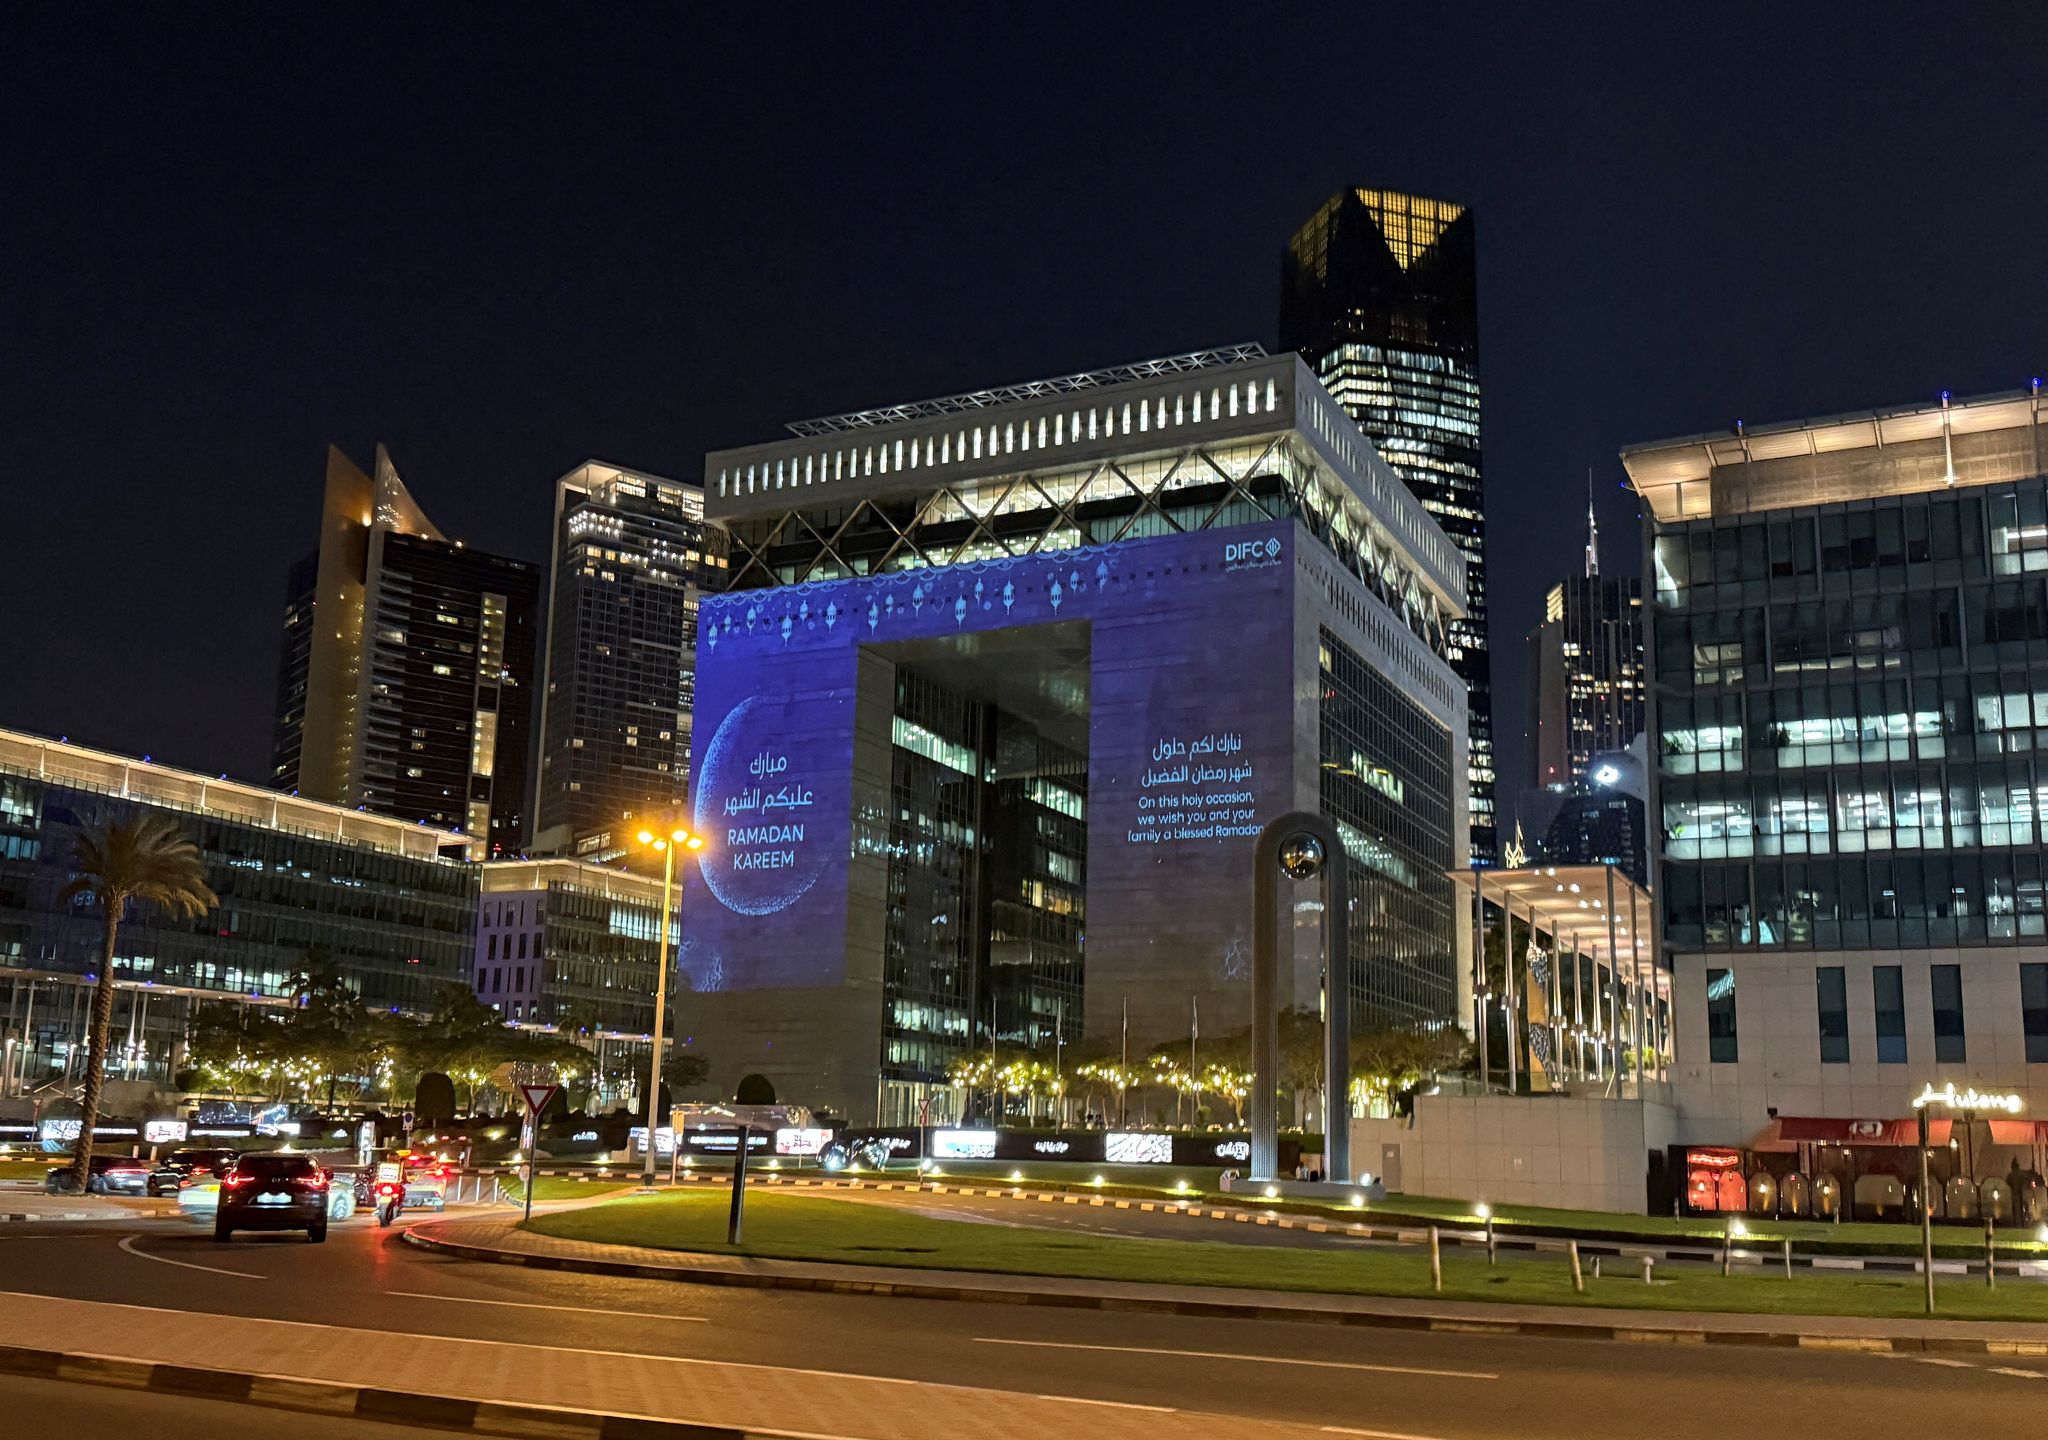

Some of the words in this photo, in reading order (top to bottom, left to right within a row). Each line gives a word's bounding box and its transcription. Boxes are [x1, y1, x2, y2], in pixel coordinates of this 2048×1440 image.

[1225, 540, 1264, 561] DIFC
[1152, 737, 1186, 761] حلول
[1189, 734, 1214, 762] لكم
[1216, 732, 1242, 756] نبارك
[750, 752, 787, 780] مبارك
[1141, 765, 1188, 788] الفضيل
[1191, 764, 1227, 785] رمضان
[1228, 759, 1252, 783] شهر
[723, 787, 760, 816] الشهر
[762, 784, 813, 815] عليكم
[1138, 796, 1156, 809] On
[1158, 794, 1179, 809] this
[1182, 793, 1204, 808] holy
[1205, 790, 1255, 805] occasion,
[1137, 815, 1155, 825] we
[1158, 811, 1185, 824] wish
[1187, 812, 1206, 825] you
[1209, 808, 1230, 821] and
[1232, 808, 1255, 824] your
[728, 824, 804, 846] RAMADAN
[1127, 829, 1161, 843] family
[1163, 830, 1172, 840] a
[1174, 825, 1214, 839] blessed
[1215, 823, 1264, 838] Ramadan
[733, 851, 794, 870] KAREEM
